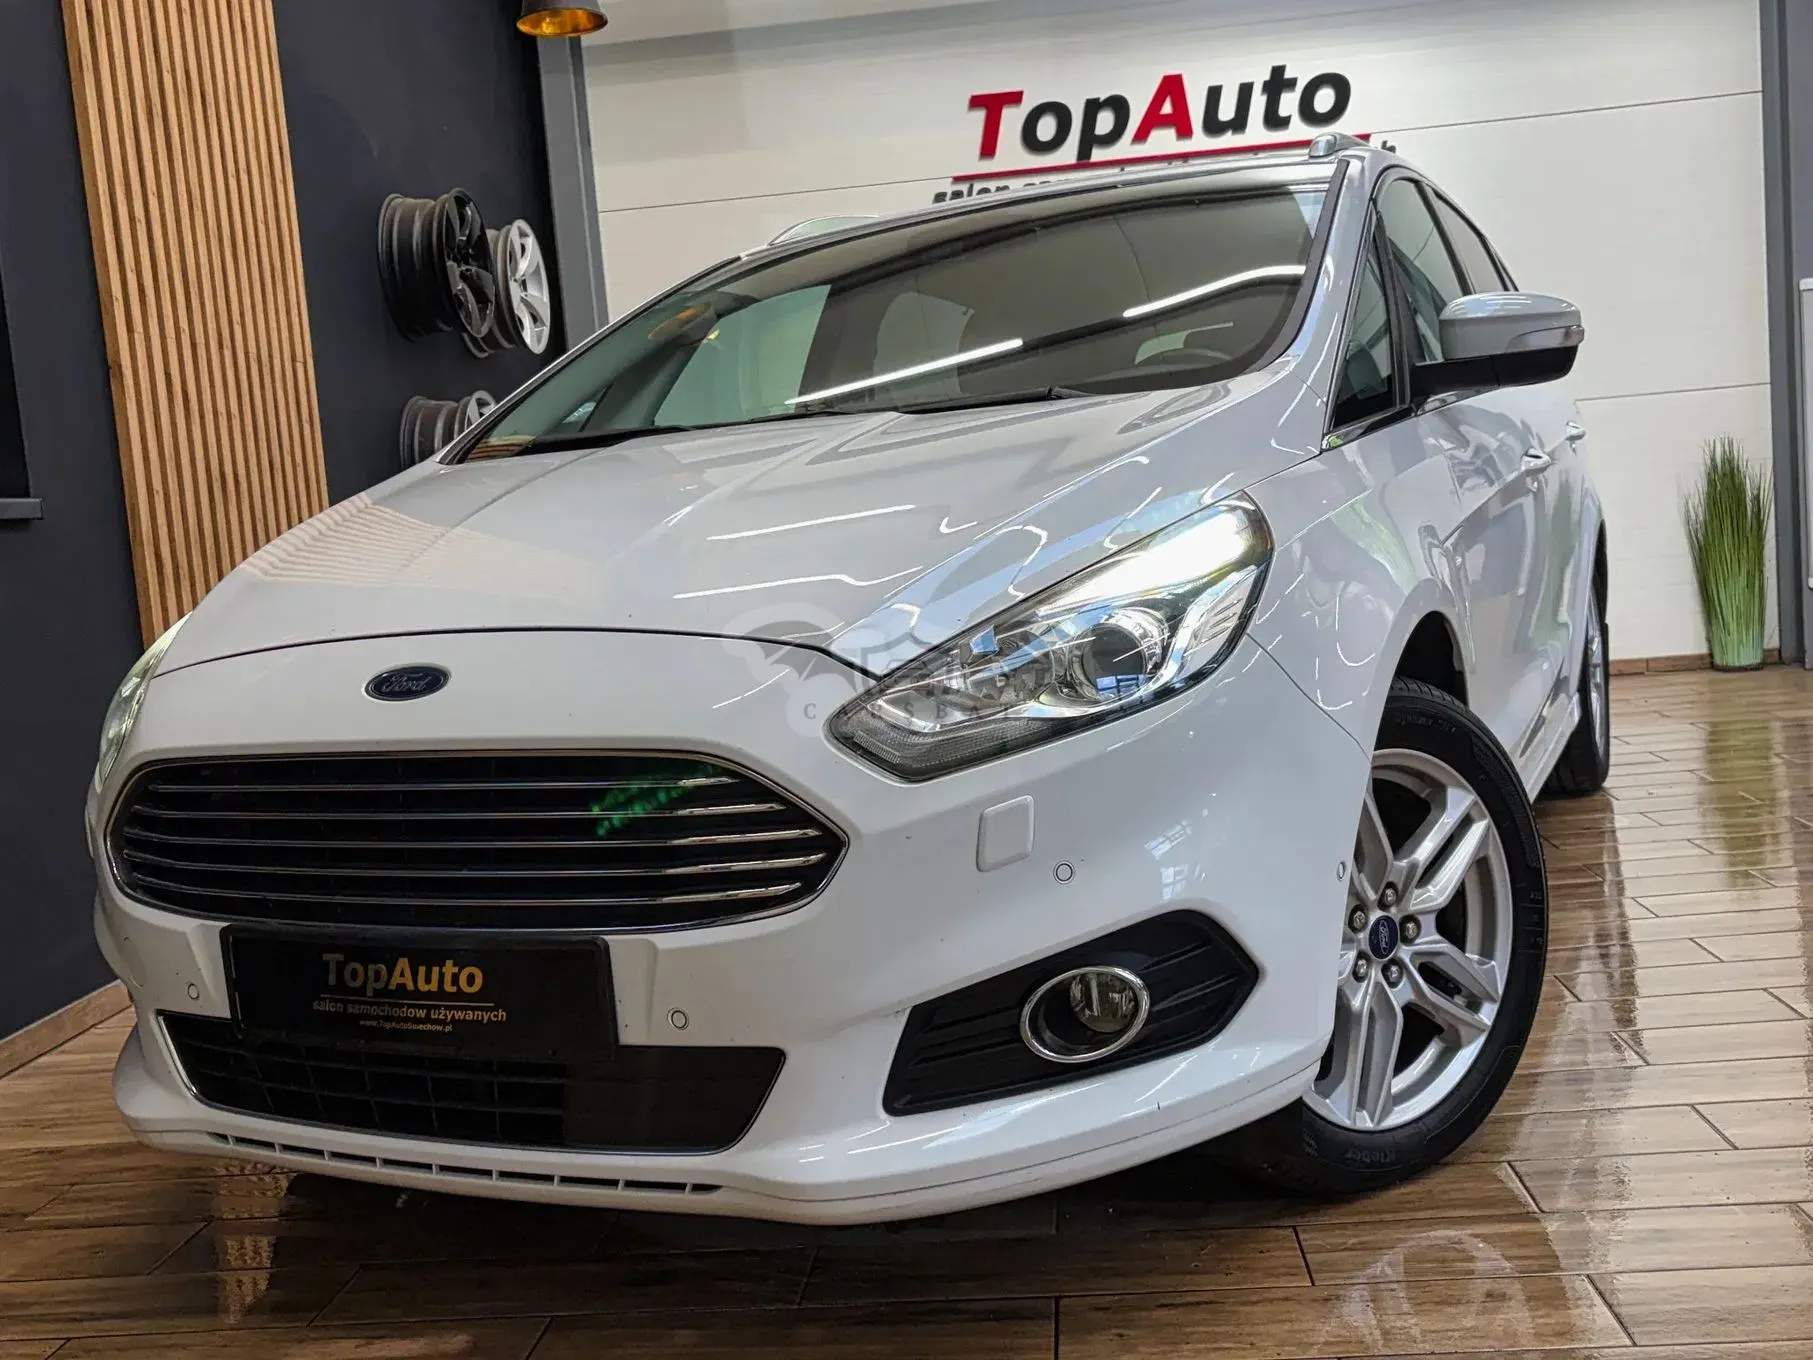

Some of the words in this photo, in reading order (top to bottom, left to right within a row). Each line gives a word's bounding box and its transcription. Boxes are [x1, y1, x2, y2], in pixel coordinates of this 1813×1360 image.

[967, 64, 1352, 162] TopAuto
[322, 953, 484, 997] TopAuto
[312, 998, 344, 1013] salon
[430, 1006, 507, 1023] używanych
